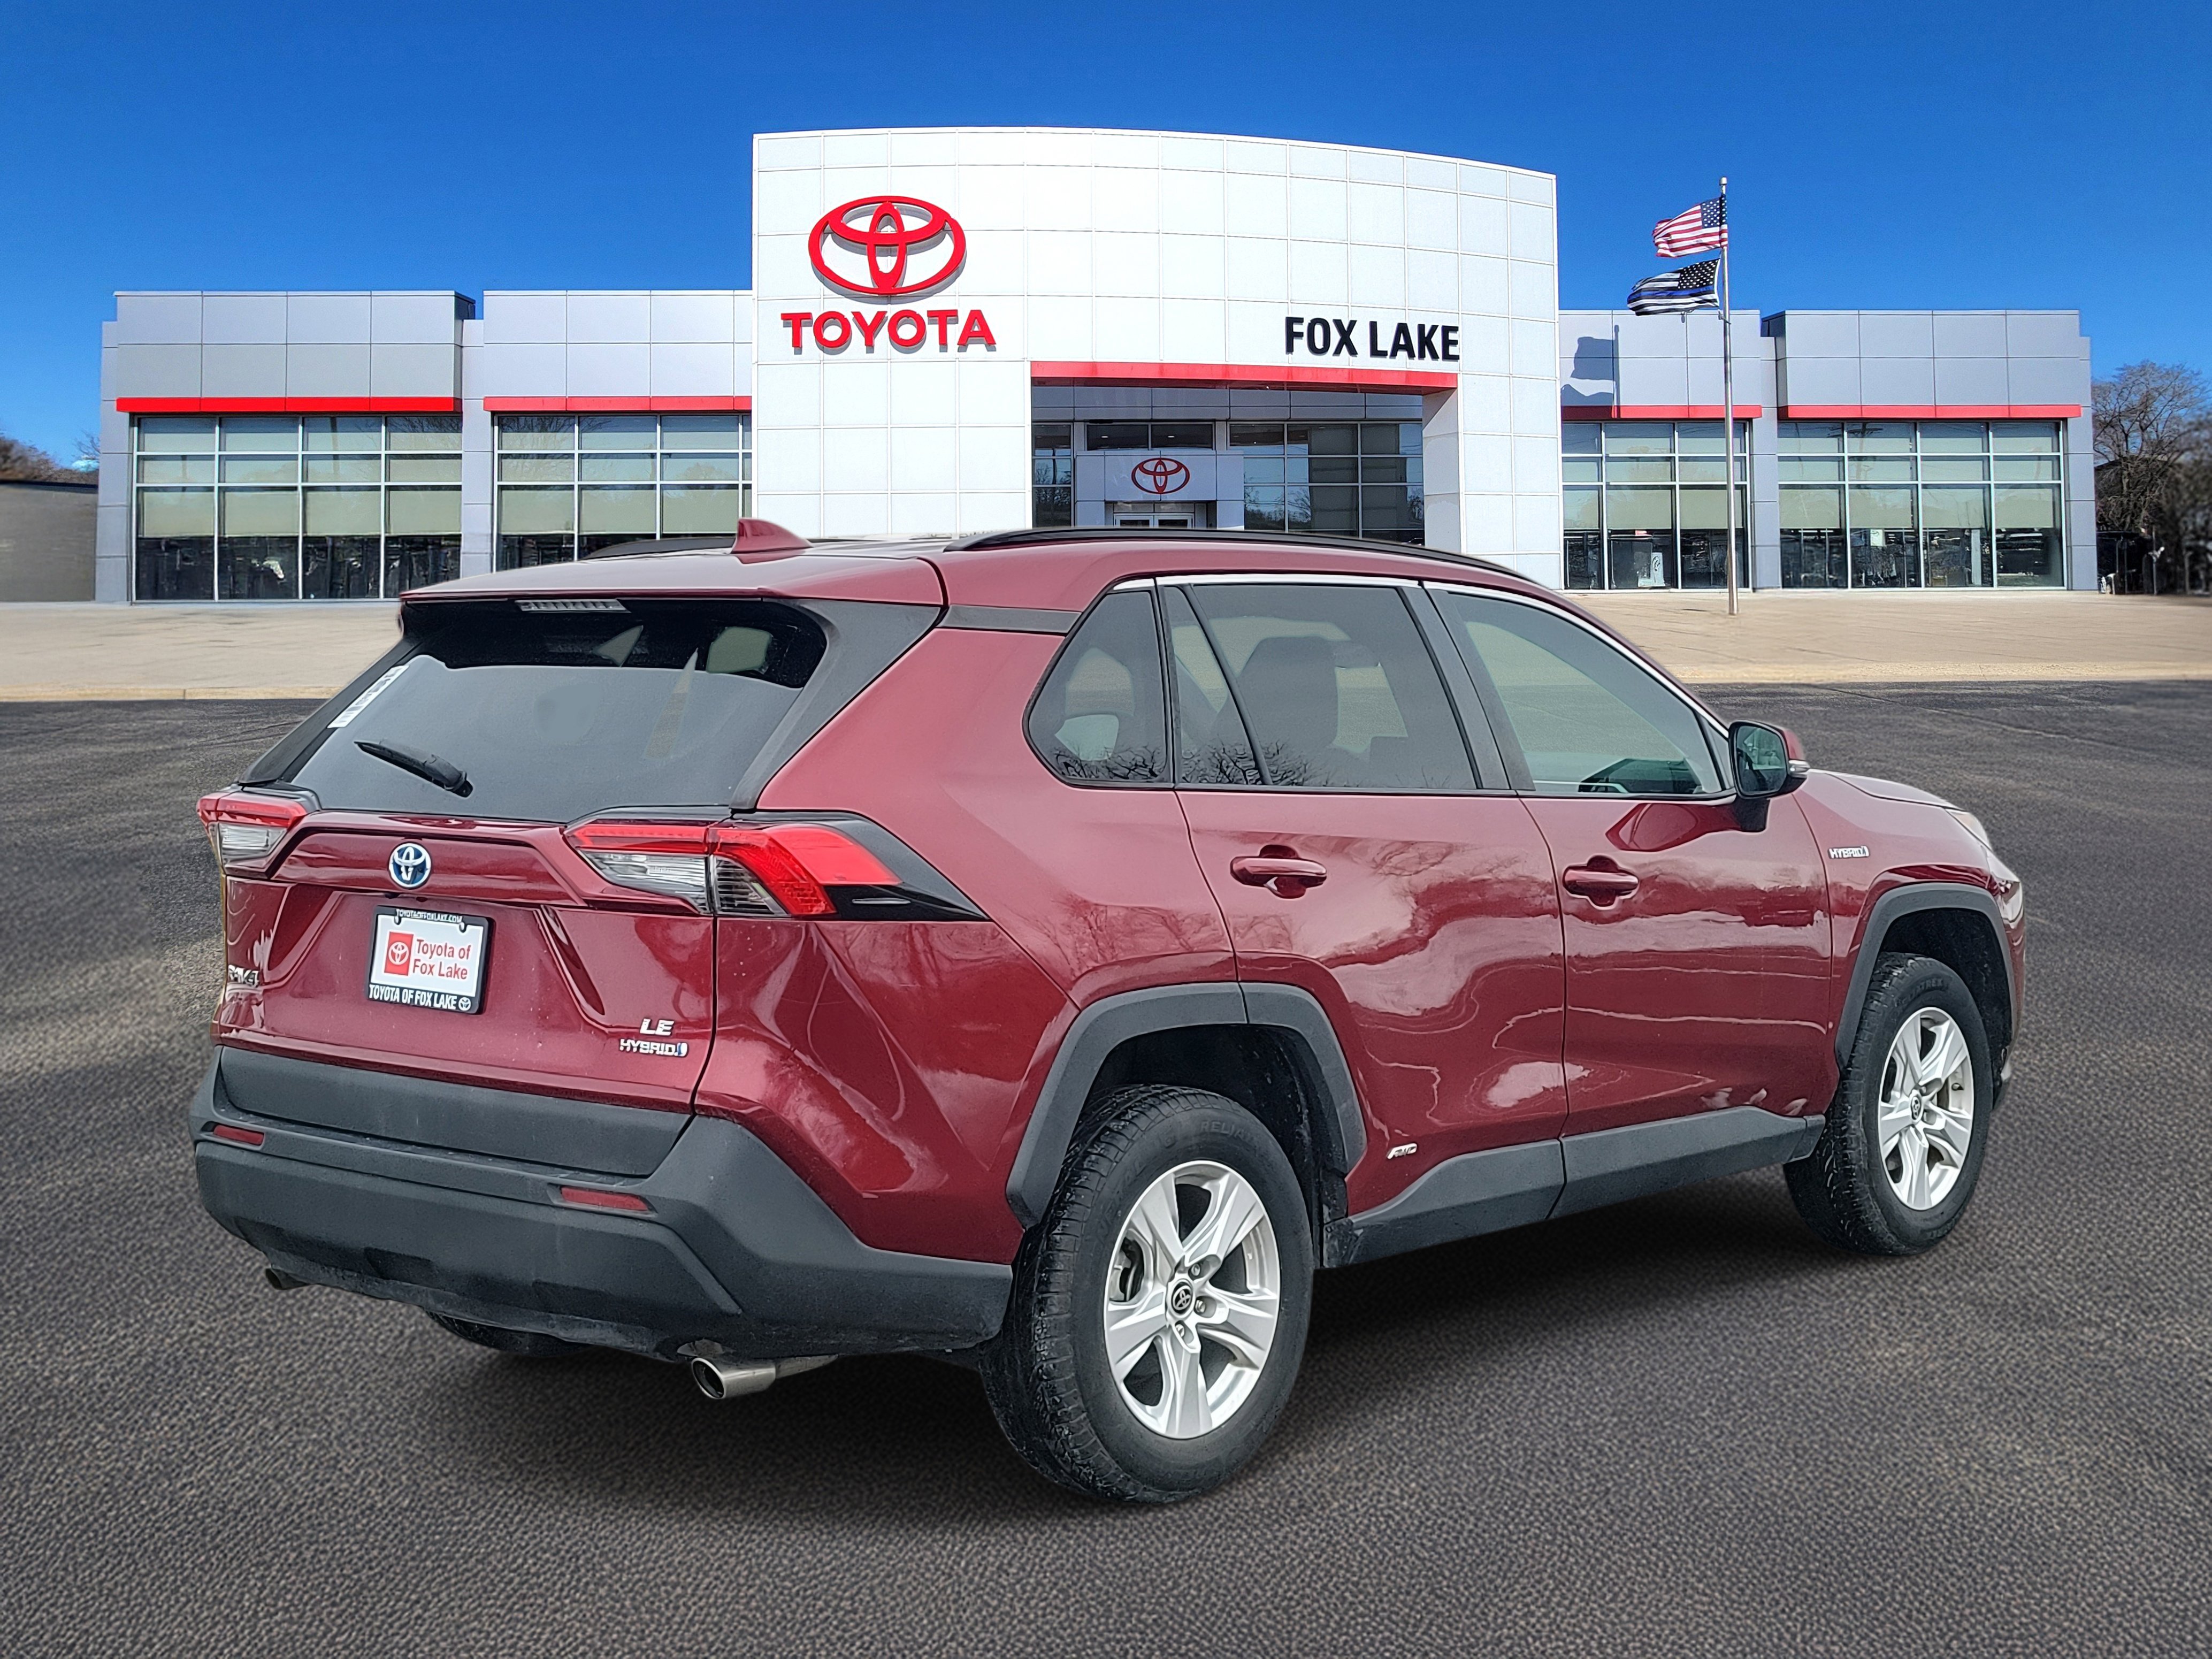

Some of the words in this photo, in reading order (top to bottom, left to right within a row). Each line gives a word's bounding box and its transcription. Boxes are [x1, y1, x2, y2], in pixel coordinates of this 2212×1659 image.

[780, 309, 997, 354] TOYOTA
[1285, 316, 1358, 357] FOX
[1369, 321, 1460, 362] LAKE
[416, 938, 455, 959] Toyota
[458, 945, 471, 960] of
[412, 959, 434, 976] Fox
[438, 961, 468, 980] Lake
[369, 984, 400, 1003] TOYOTA
[402, 989, 414, 1004] OF
[414, 990, 433, 1007] FOX
[433, 993, 457, 1010] LAKE
[640, 1018, 675, 1036] LE
[619, 1038, 677, 1056] HYBRID
